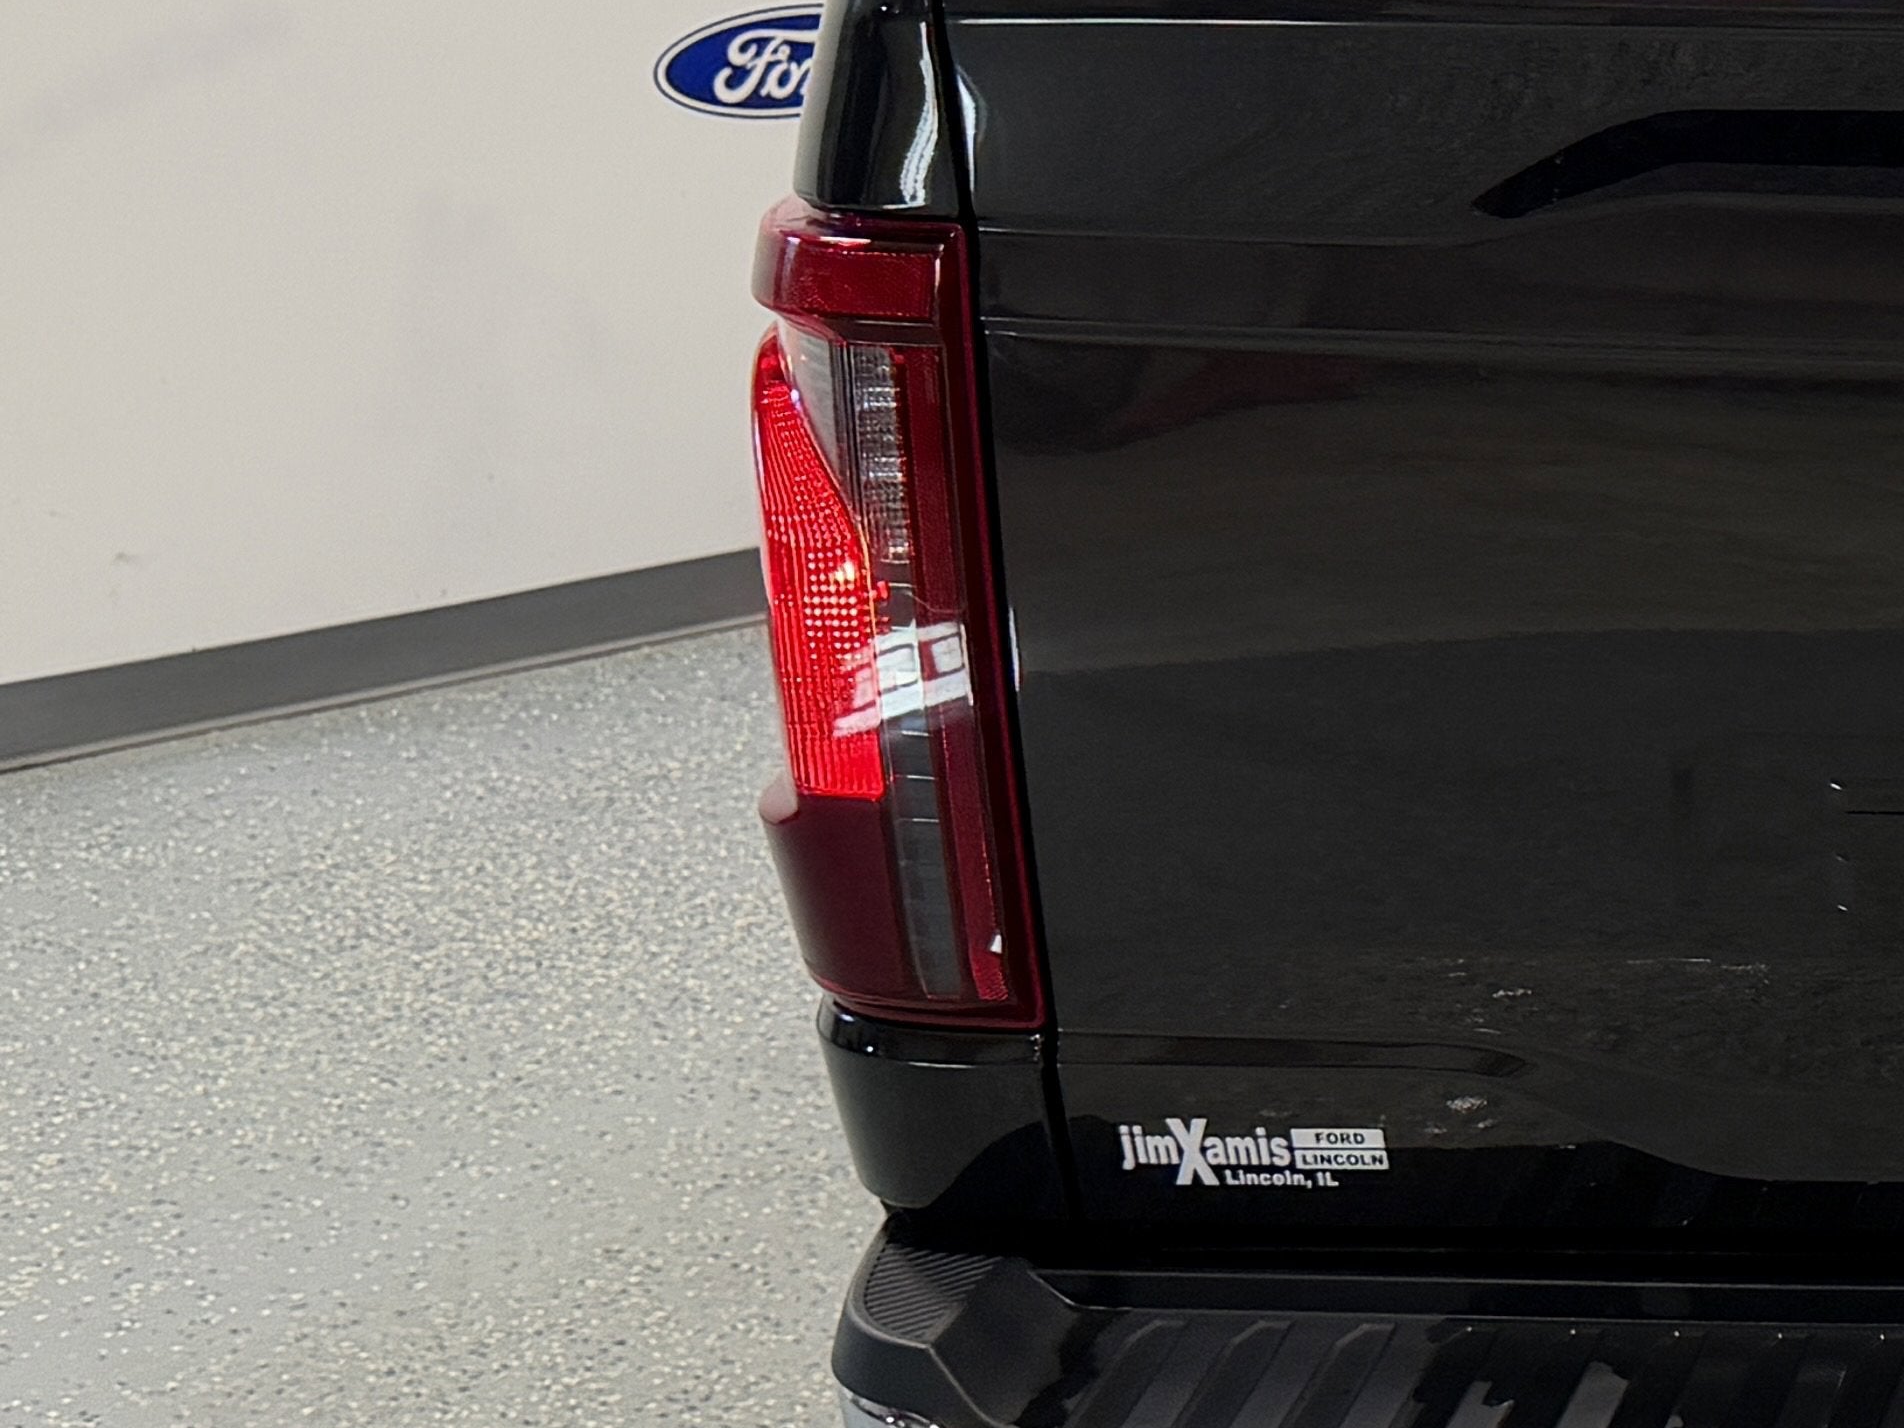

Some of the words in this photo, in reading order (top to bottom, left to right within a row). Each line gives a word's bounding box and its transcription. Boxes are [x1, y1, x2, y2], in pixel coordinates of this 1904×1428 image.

[1314, 1132, 1366, 1145] FORD
[1301, 1153, 1385, 1166] LINCOLN
[1224, 1169, 1313, 1189] Lincoln,
[1316, 1171, 1340, 1187] IL
